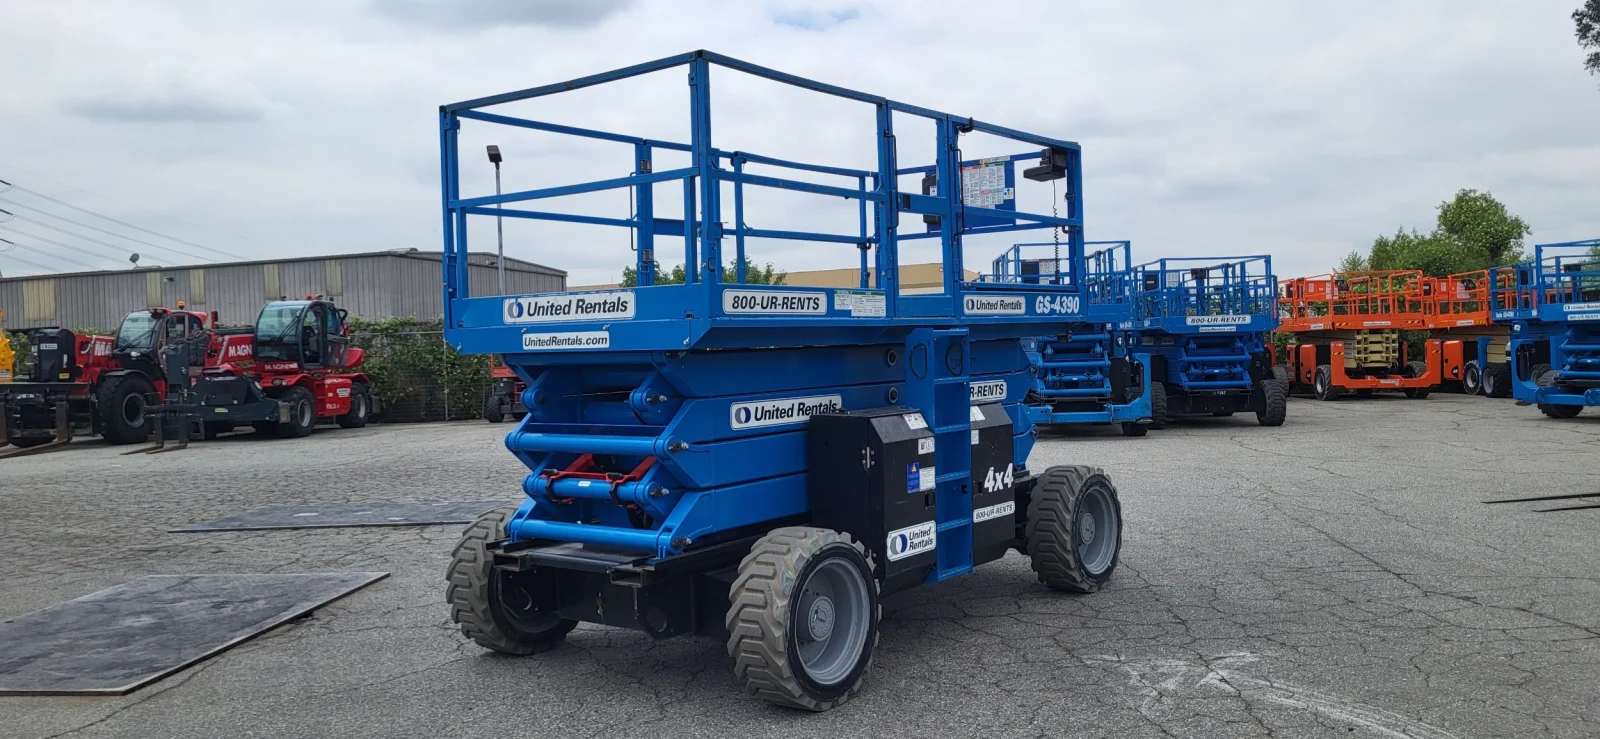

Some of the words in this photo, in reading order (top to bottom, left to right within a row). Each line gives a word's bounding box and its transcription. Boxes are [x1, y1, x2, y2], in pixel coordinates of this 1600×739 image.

[527, 299, 572, 317] United
[575, 296, 628, 314] Rentals
[731, 295, 821, 311] 800-UR-RENTS
[976, 299, 998, 310] United
[999, 299, 1022, 310] Rentals
[1035, 295, 1080, 314] GS-4390
[1190, 316, 1247, 324] 800-UR-RENTS
[523, 334, 607, 348] UnitedRentals.com
[228, 344, 253, 358] MAGN
[969, 383, 1005, 398] R-RENTS
[753, 401, 795, 422] United
[796, 398, 838, 417] Rentals
[983, 462, 1014, 493] 4x4
[975, 503, 1013, 520] 800-UR-RENTS
[908, 526, 932, 541] United
[908, 536, 933, 552] Rentals
